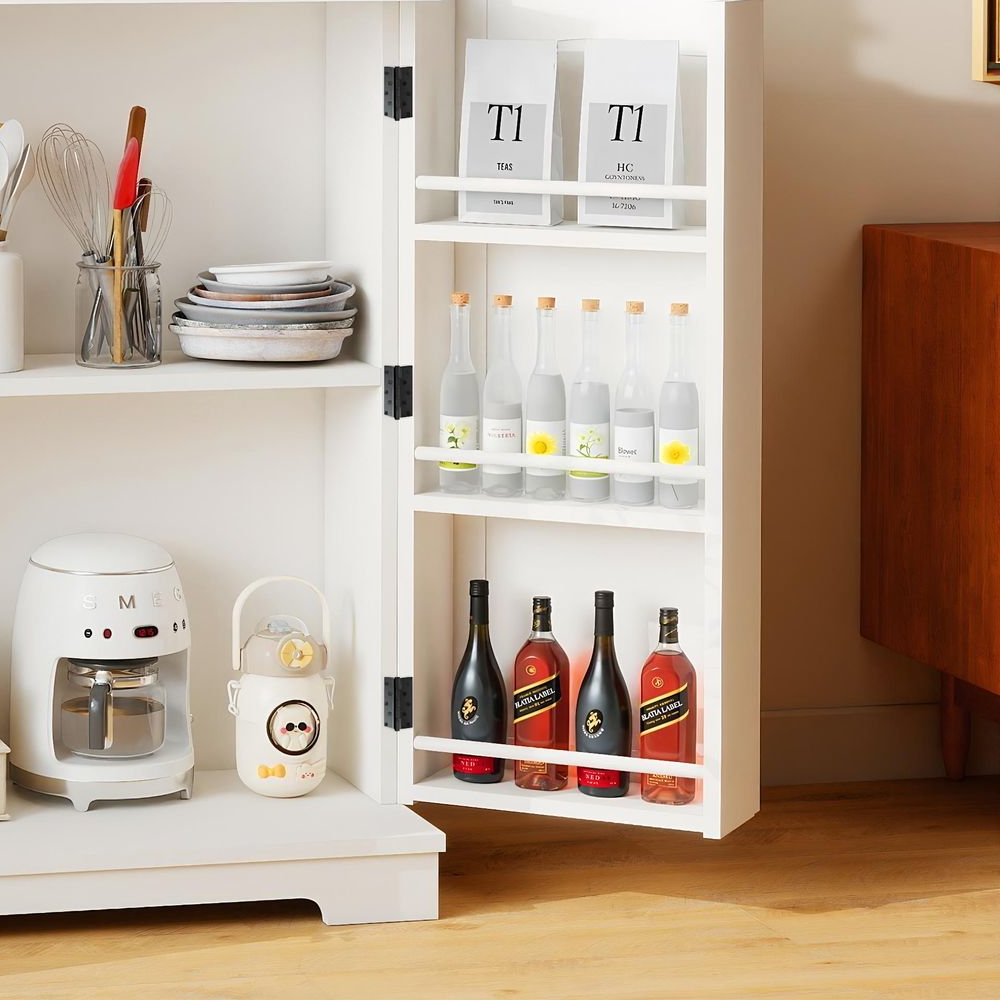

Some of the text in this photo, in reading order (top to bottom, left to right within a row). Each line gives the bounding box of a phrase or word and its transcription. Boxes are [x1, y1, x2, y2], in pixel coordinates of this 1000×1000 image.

[488, 104, 522, 142] T1
[608, 104, 644, 142] T1
[496, 162, 513, 171] TEAS
[617, 163, 634, 172] HC
[534, 688, 556, 700] LABEL
[662, 700, 683, 714] LABEL
